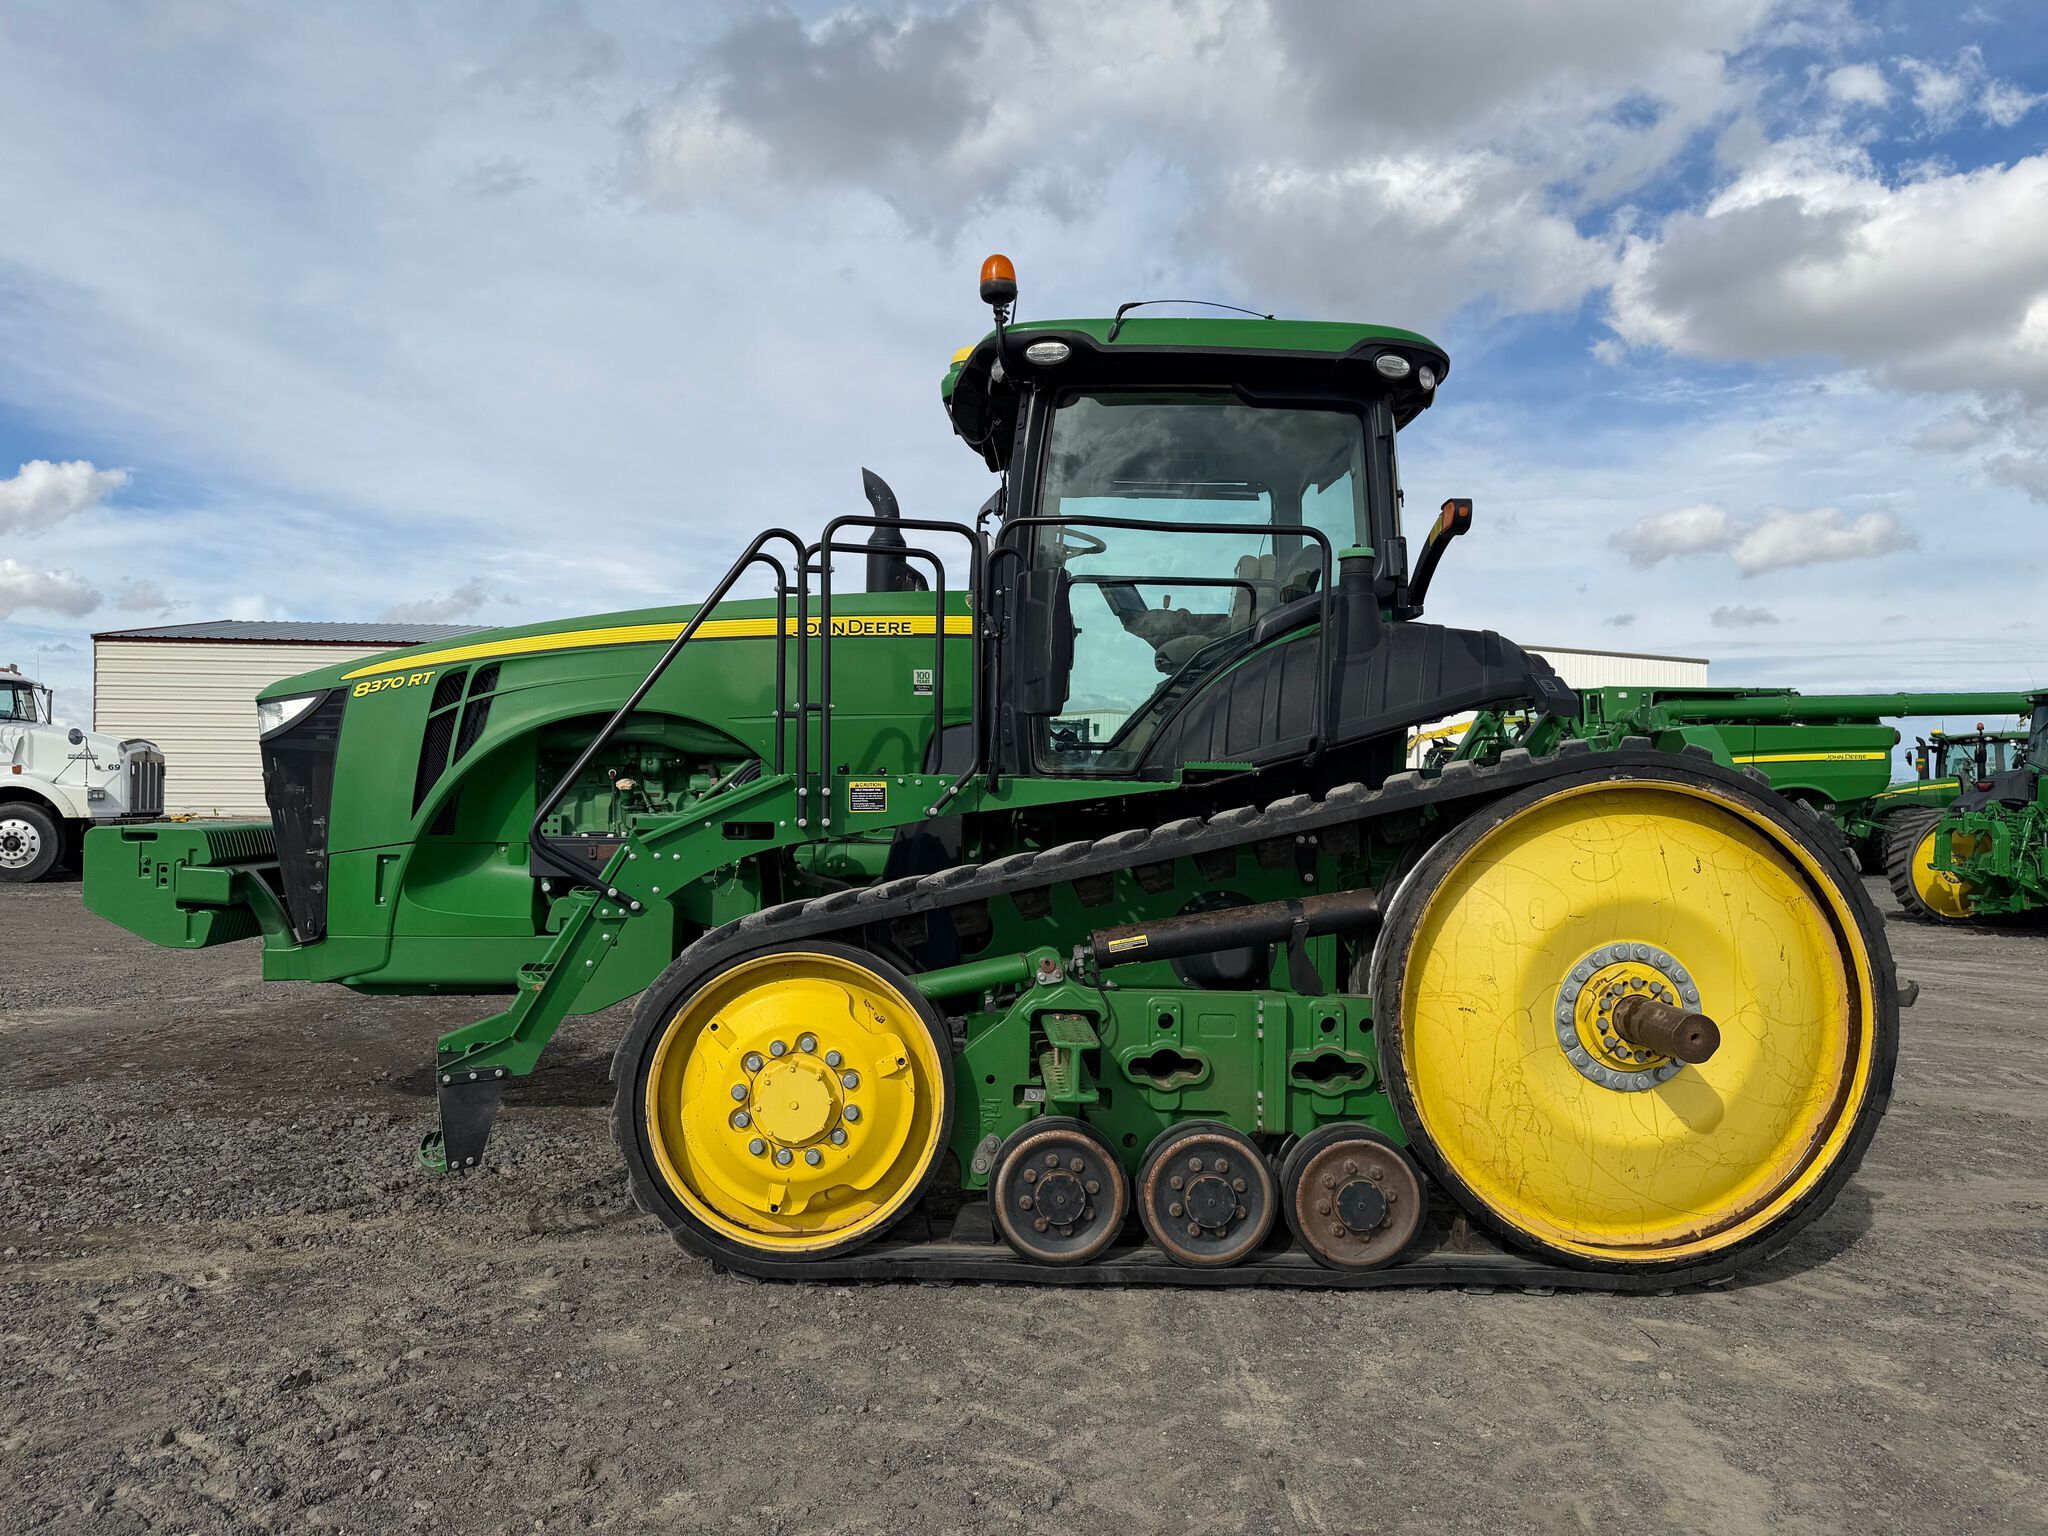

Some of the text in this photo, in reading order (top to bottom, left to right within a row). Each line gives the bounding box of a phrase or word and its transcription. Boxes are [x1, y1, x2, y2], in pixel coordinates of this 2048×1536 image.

[792, 620, 912, 635] ON DEERE
[915, 671, 930, 680] 100
[352, 671, 436, 698] 8370 RT
[108, 763, 121, 771] 69
